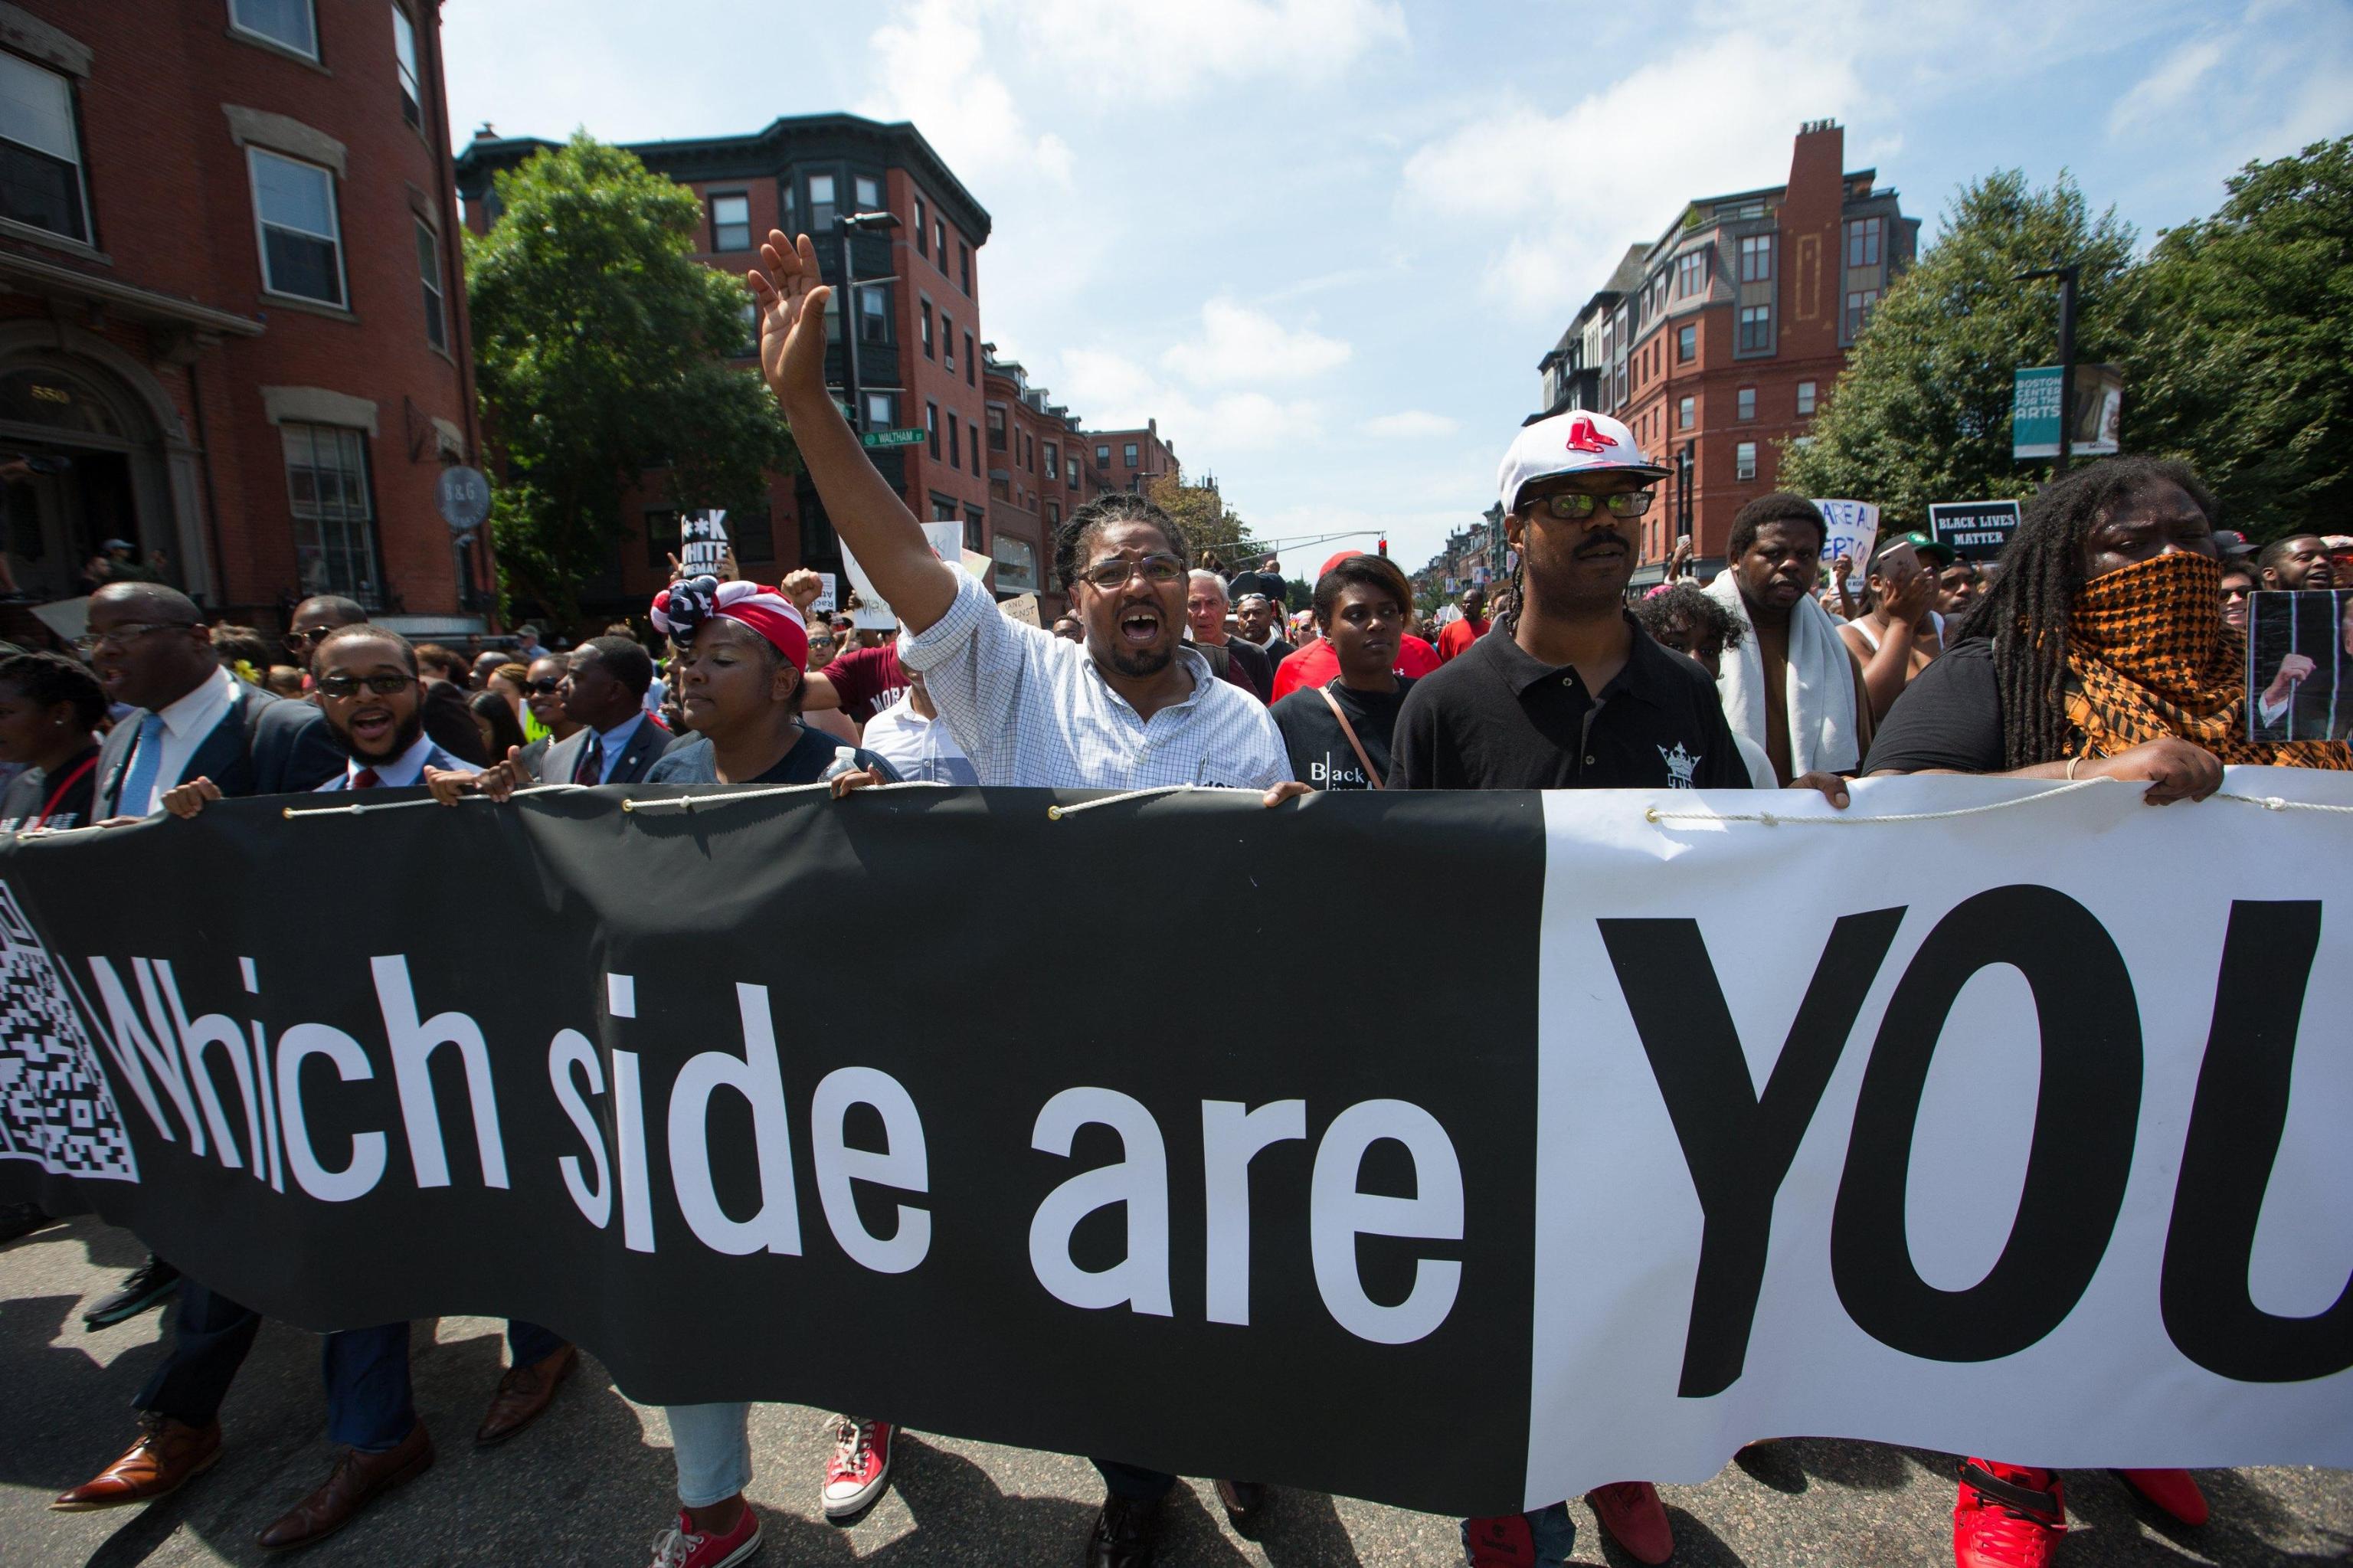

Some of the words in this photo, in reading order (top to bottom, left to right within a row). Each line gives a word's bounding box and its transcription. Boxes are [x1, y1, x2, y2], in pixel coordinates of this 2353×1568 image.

[2016, 377, 2063, 390] BOSTON
[2016, 387, 2063, 398] CENTER
[2016, 397, 2038, 407] FOR
[2040, 395, 2063, 405] THE
[2015, 405, 2061, 421] ARTS
[878, 430, 913, 443] WALTHAM
[1824, 502, 1853, 525] ARE
[1939, 516, 1976, 530] BLACK
[1979, 514, 2015, 528] LIVES
[1954, 532, 2004, 546] MATTER
[1311, 751, 1365, 790] Black
[57, 954, 510, 1202] Which
[548, 971, 931, 1274] side
[1029, 1086, 1464, 1344] are
[1595, 884, 2353, 1398] YOU
